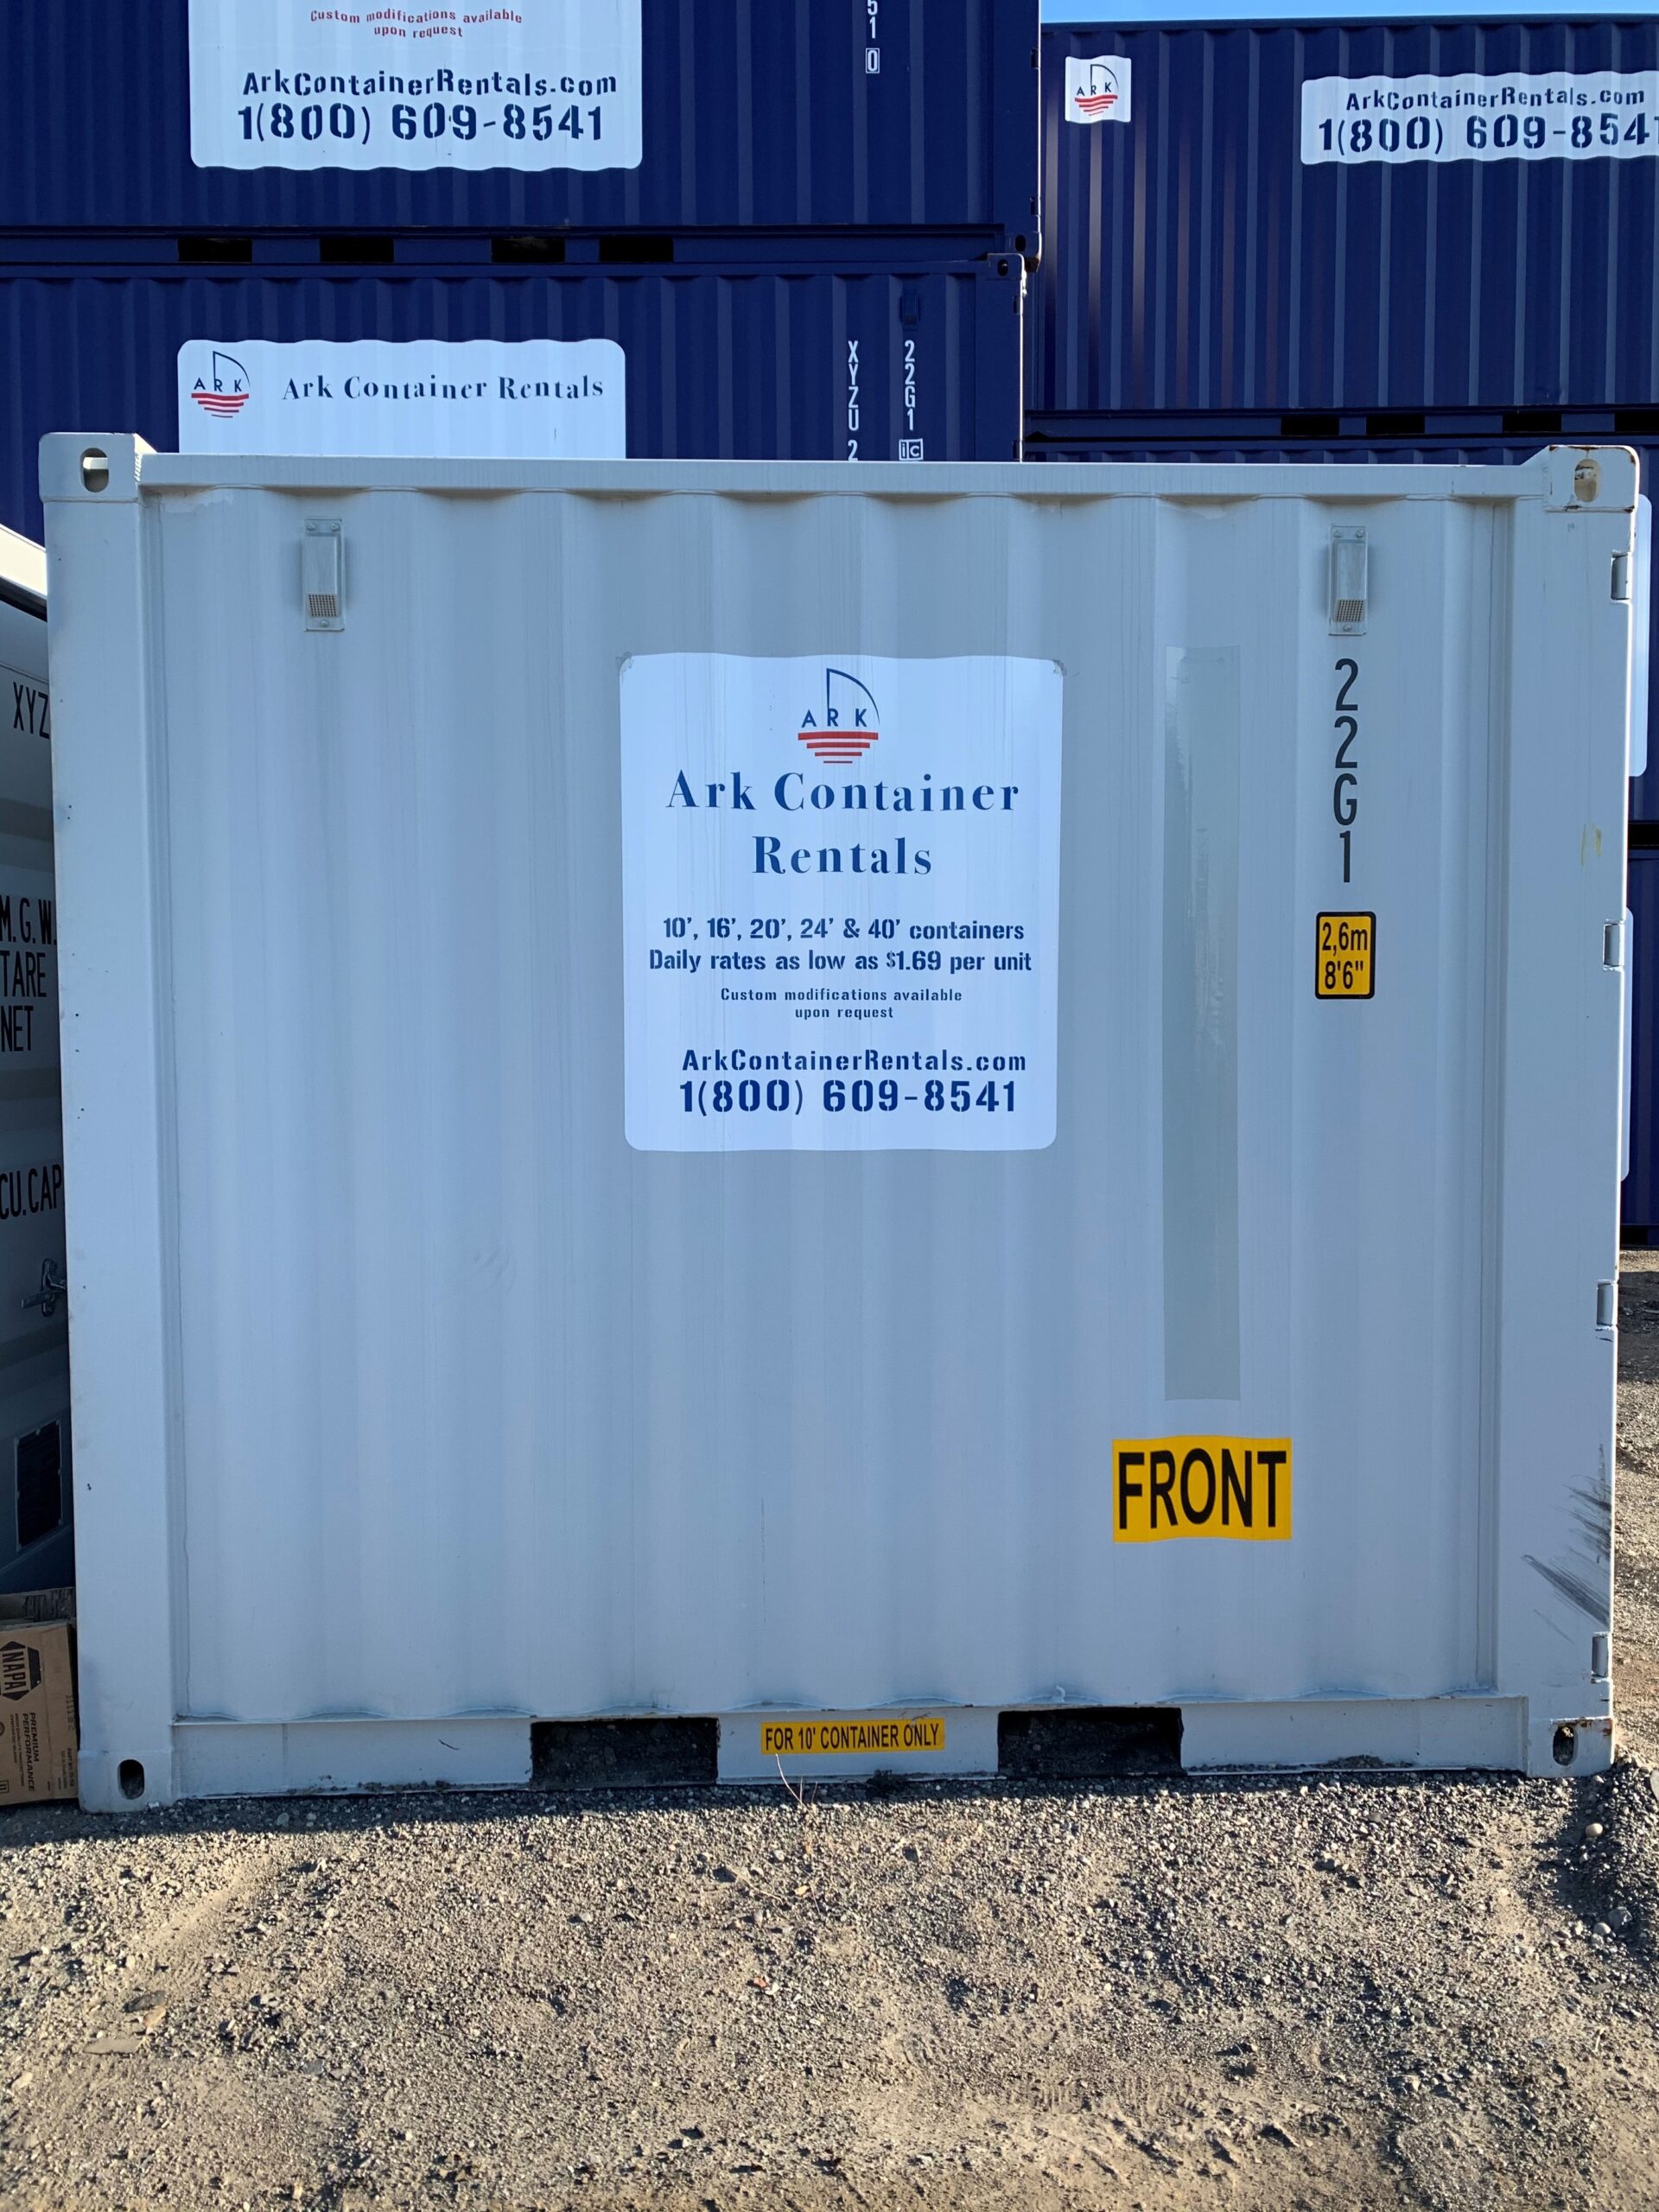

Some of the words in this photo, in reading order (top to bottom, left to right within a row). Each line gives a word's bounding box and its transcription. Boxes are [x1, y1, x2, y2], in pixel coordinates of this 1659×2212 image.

[310, 10, 360, 23] Custom
[365, 8, 456, 23] modifications
[462, 8, 522, 23] available
[374, 26, 406, 38] upon
[412, 26, 463, 39] request
[243, 68, 617, 97] ArkContainerRentals.com
[1077, 82, 1112, 96] ARK
[1345, 86, 1644, 111] ArkContainerRentals.com
[238, 102, 371, 145] 1(800)
[391, 102, 601, 142] 609-8541
[1319, 116, 1443, 156] 1(800)
[194, 378, 242, 392] ARK
[283, 375, 333, 400] Ark
[344, 374, 487, 400] Container
[499, 374, 603, 400] Rentals
[848, 340, 859, 431] XYZU
[905, 340, 915, 431] 22G1
[801, 709, 868, 728] ARK
[1333, 658, 1359, 883] 22G1
[667, 769, 757, 810] Ark
[774, 772, 1019, 812] Container
[752, 836, 931, 875] Rentals
[663, 917, 698, 941] 10',
[707, 917, 742, 941] 16',
[749, 918, 792, 942] 20',
[800, 917, 834, 939] 24'
[842, 918, 861, 939] &
[868, 918, 900, 939] 40'
[909, 920, 1025, 940] containers
[1322, 922, 1368, 957] 2,6m
[0, 950, 47, 998] TARE
[649, 949, 702, 974] Daily
[710, 951, 766, 970] rates
[775, 956, 800, 970] as
[809, 949, 846, 970] low
[855, 955, 879, 970] as
[886, 950, 942, 971] $1.69
[950, 956, 986, 975] per
[994, 951, 1032, 971] unit
[721, 988, 777, 1001] Custom
[785, 988, 887, 1001] modifications
[893, 988, 963, 1001] available
[0, 1005, 34, 1052] NET
[795, 1008, 830, 1020] upon
[837, 1007, 893, 1020] request
[682, 1048, 1026, 1071] ArkContainerRentals.com
[679, 1079, 803, 1117] 1(800)
[823, 1079, 1014, 1113] 609-8541
[1118, 1447, 1287, 1530] FRONT
[2, 1651, 27, 1690] NAPA
[22, 1713, 35, 1793] PERFORMANCE
[29, 1712, 40, 1763] PREMIUM
[765, 1727, 794, 1751] FOR
[798, 1726, 817, 1751] 10'
[820, 1724, 899, 1750] CONTAINER
[903, 1723, 939, 1747] ONLY
